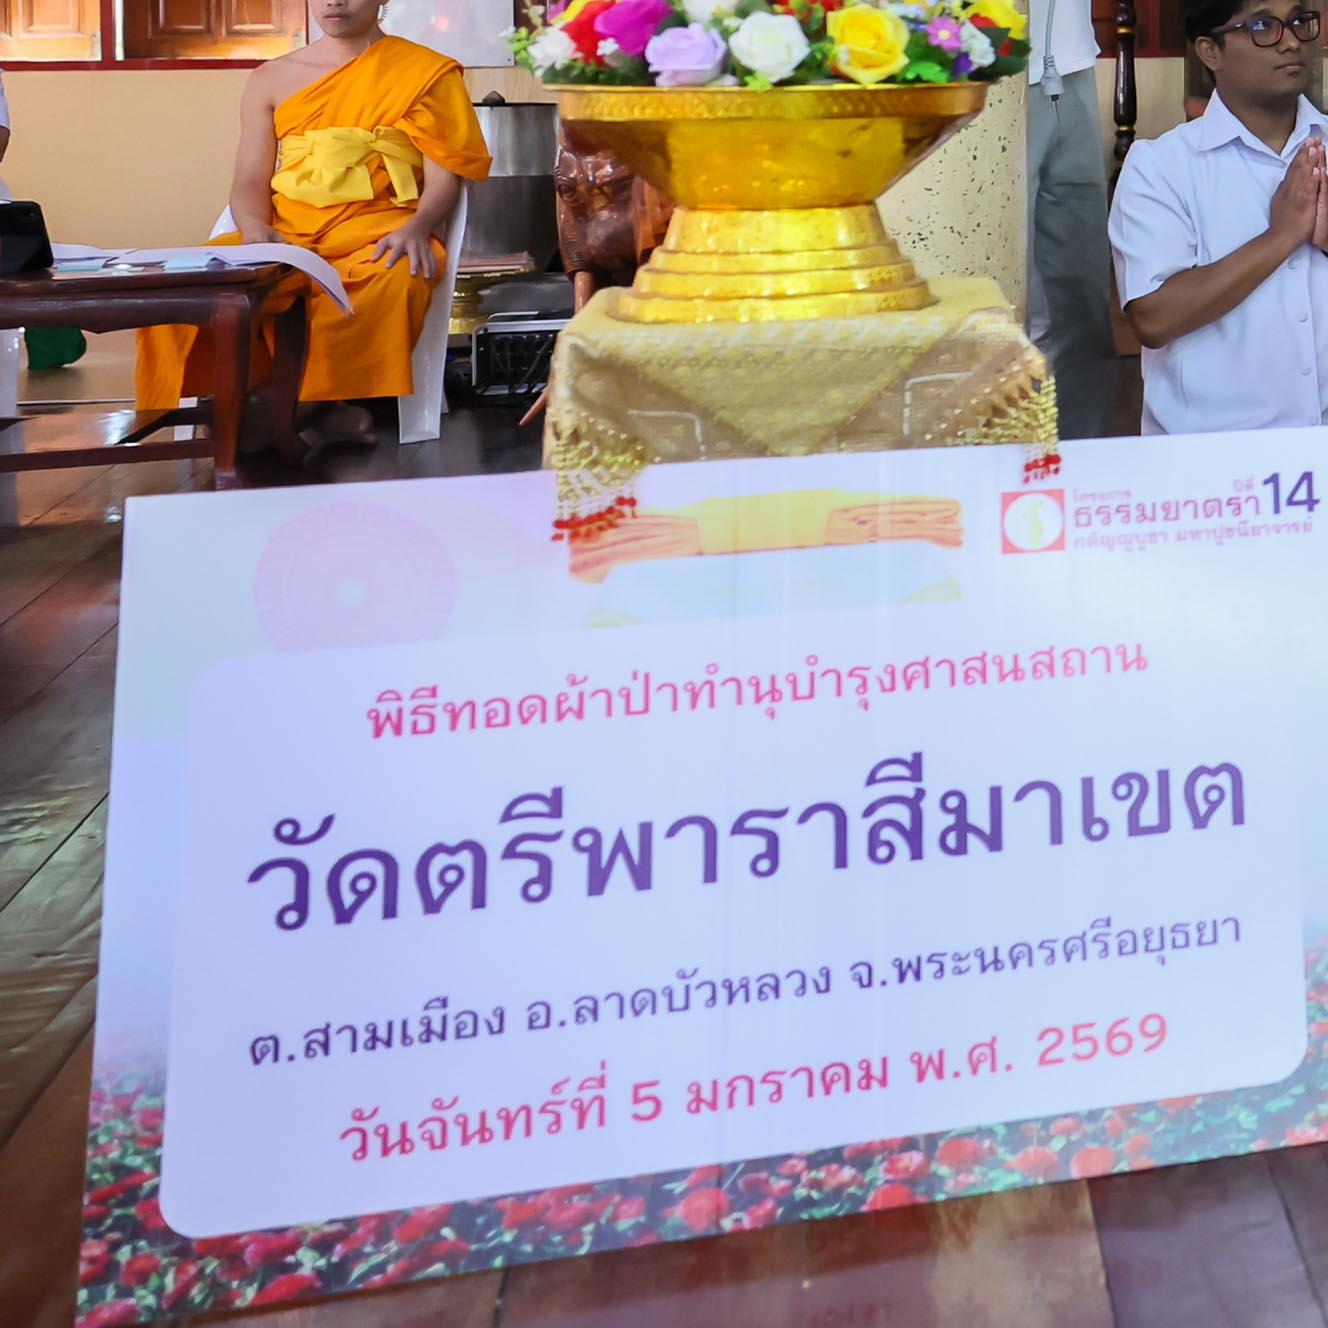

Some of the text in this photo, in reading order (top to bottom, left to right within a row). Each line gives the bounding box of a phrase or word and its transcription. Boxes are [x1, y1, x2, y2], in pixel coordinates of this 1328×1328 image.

[1074, 495, 1260, 529] ธรรมยาตรา
[1262, 471, 1320, 515] 14
[366, 642, 1149, 739] พิธีทอดผ้าป่าทำนุบำรุงศาสนสถาน
[247, 751, 1245, 931] วัดตรีพาราสีมาเขต
[249, 916, 1242, 1066] ต.สามเมือง อ.ลาดบัวหลวง จ.พระนครศรีอยุธยา
[339, 1013, 1168, 1162] วันจันทร์ที่ 5 มกราคม พ.ศ. 2569
